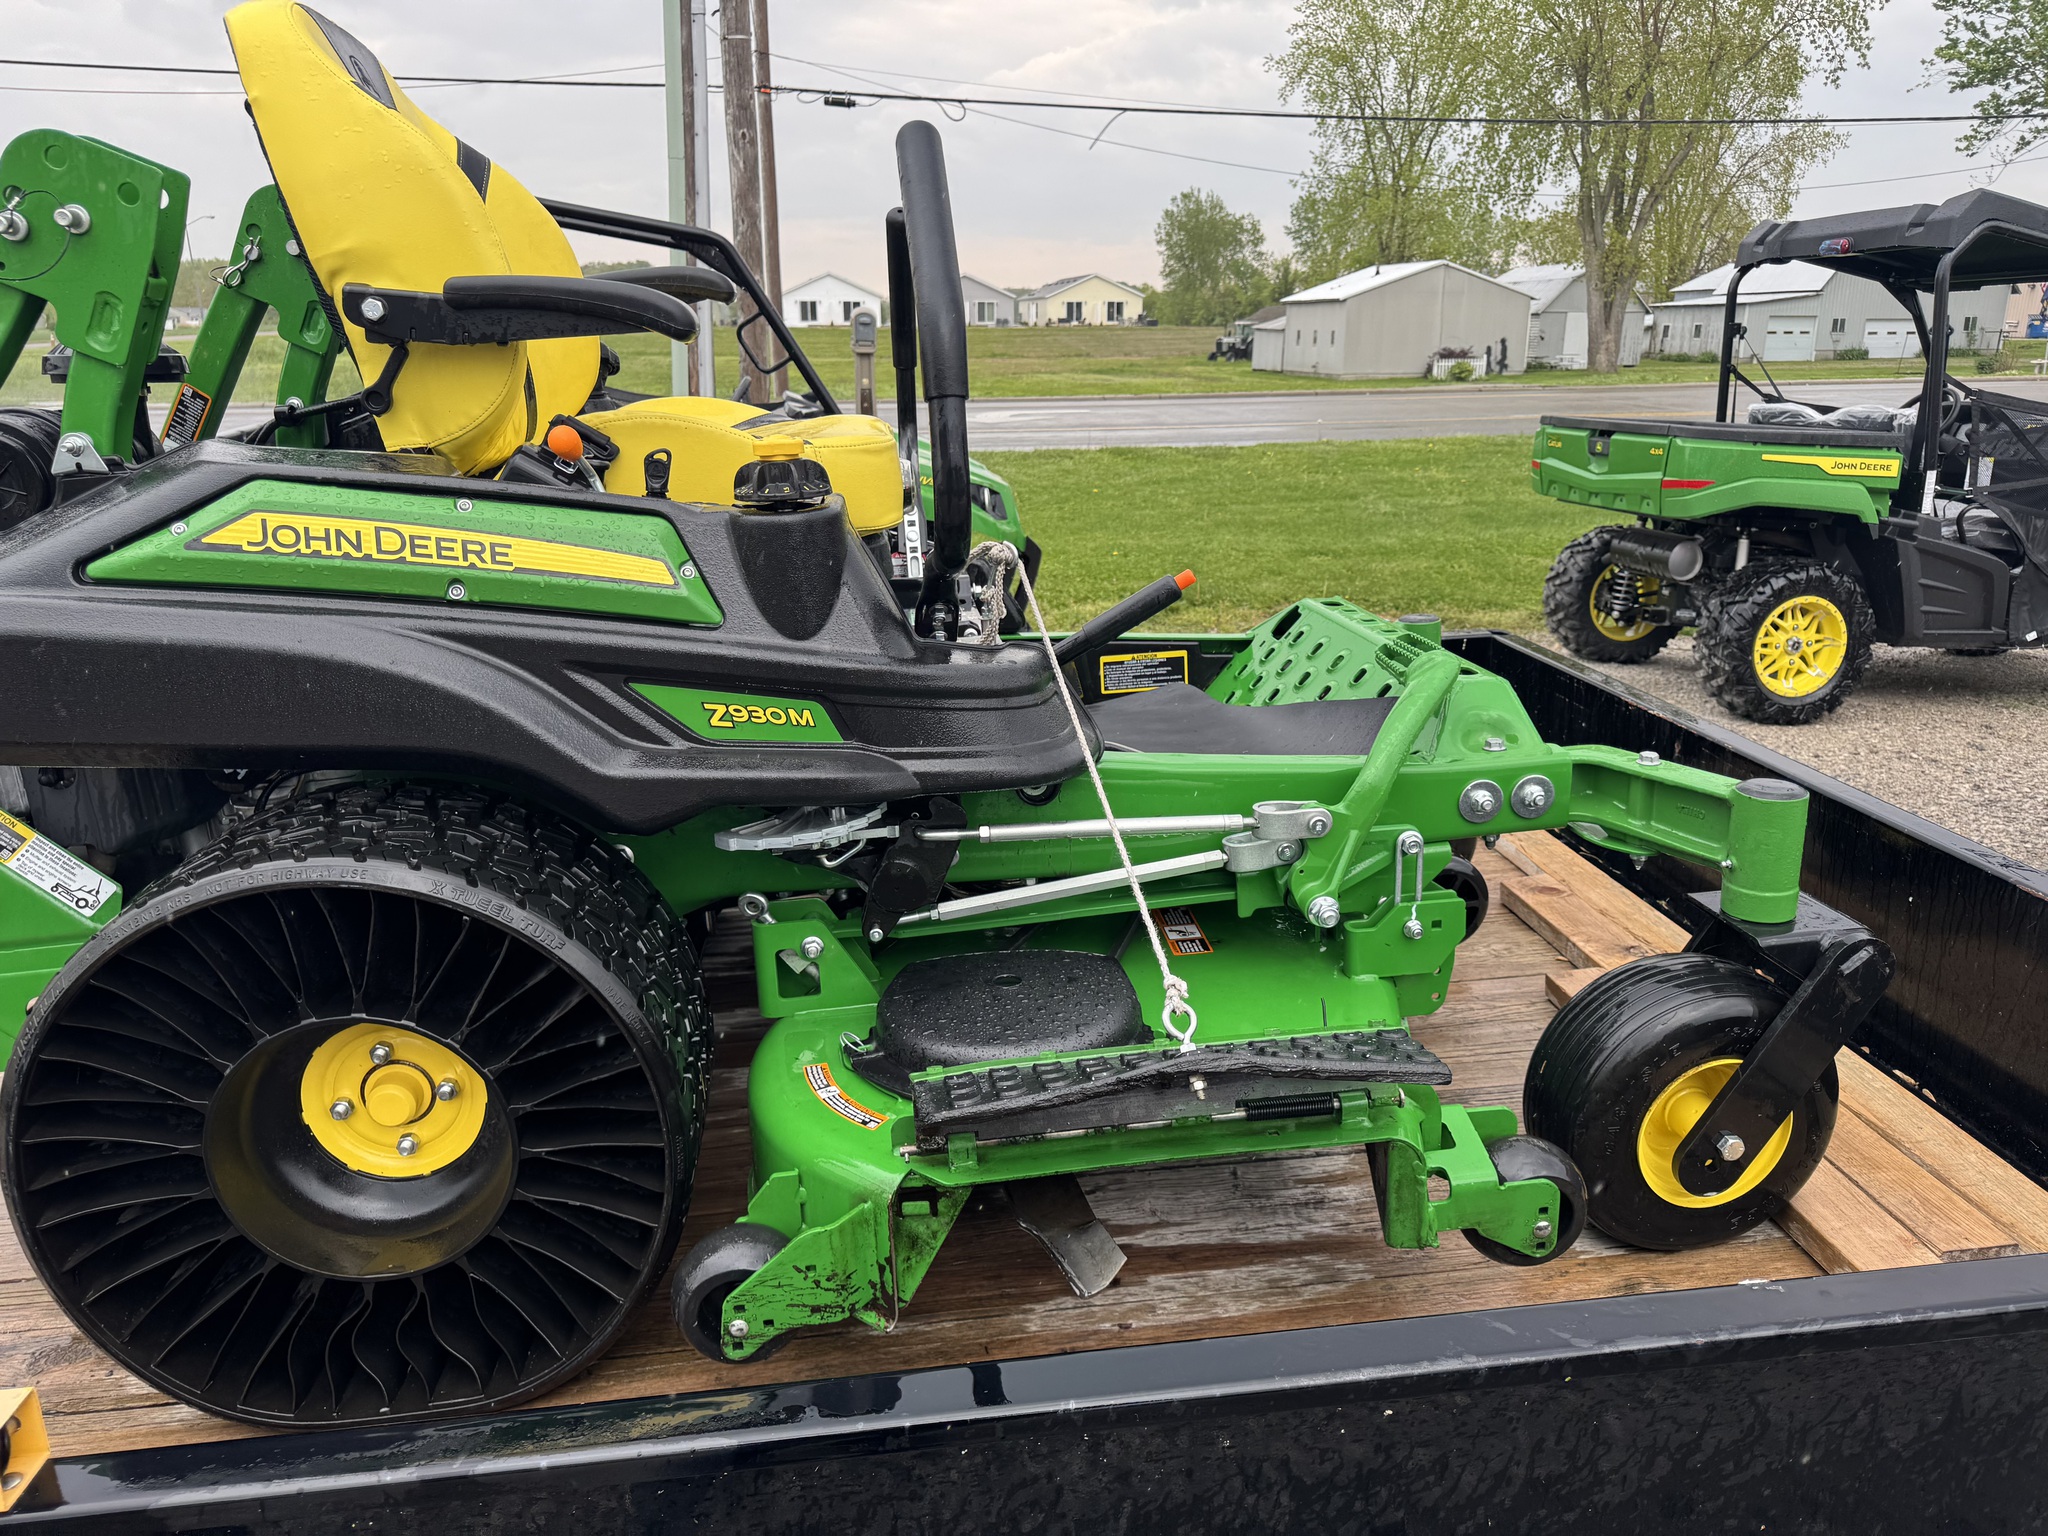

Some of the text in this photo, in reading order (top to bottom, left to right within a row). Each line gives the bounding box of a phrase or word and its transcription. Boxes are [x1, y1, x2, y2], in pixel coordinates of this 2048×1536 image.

[1831, 461, 1892, 472] JOHN DEERE
[246, 518, 514, 567] JOHN DEERE
[702, 702, 816, 729] Z930M
[205, 881, 233, 897] NOT
[237, 871, 264, 888] FOR
[270, 868, 335, 883] HIGHWAY
[340, 868, 369, 880] USE
[450, 888, 515, 923] TWEEL
[519, 917, 567, 951] TURF
[604, 984, 627, 1011] MADE
